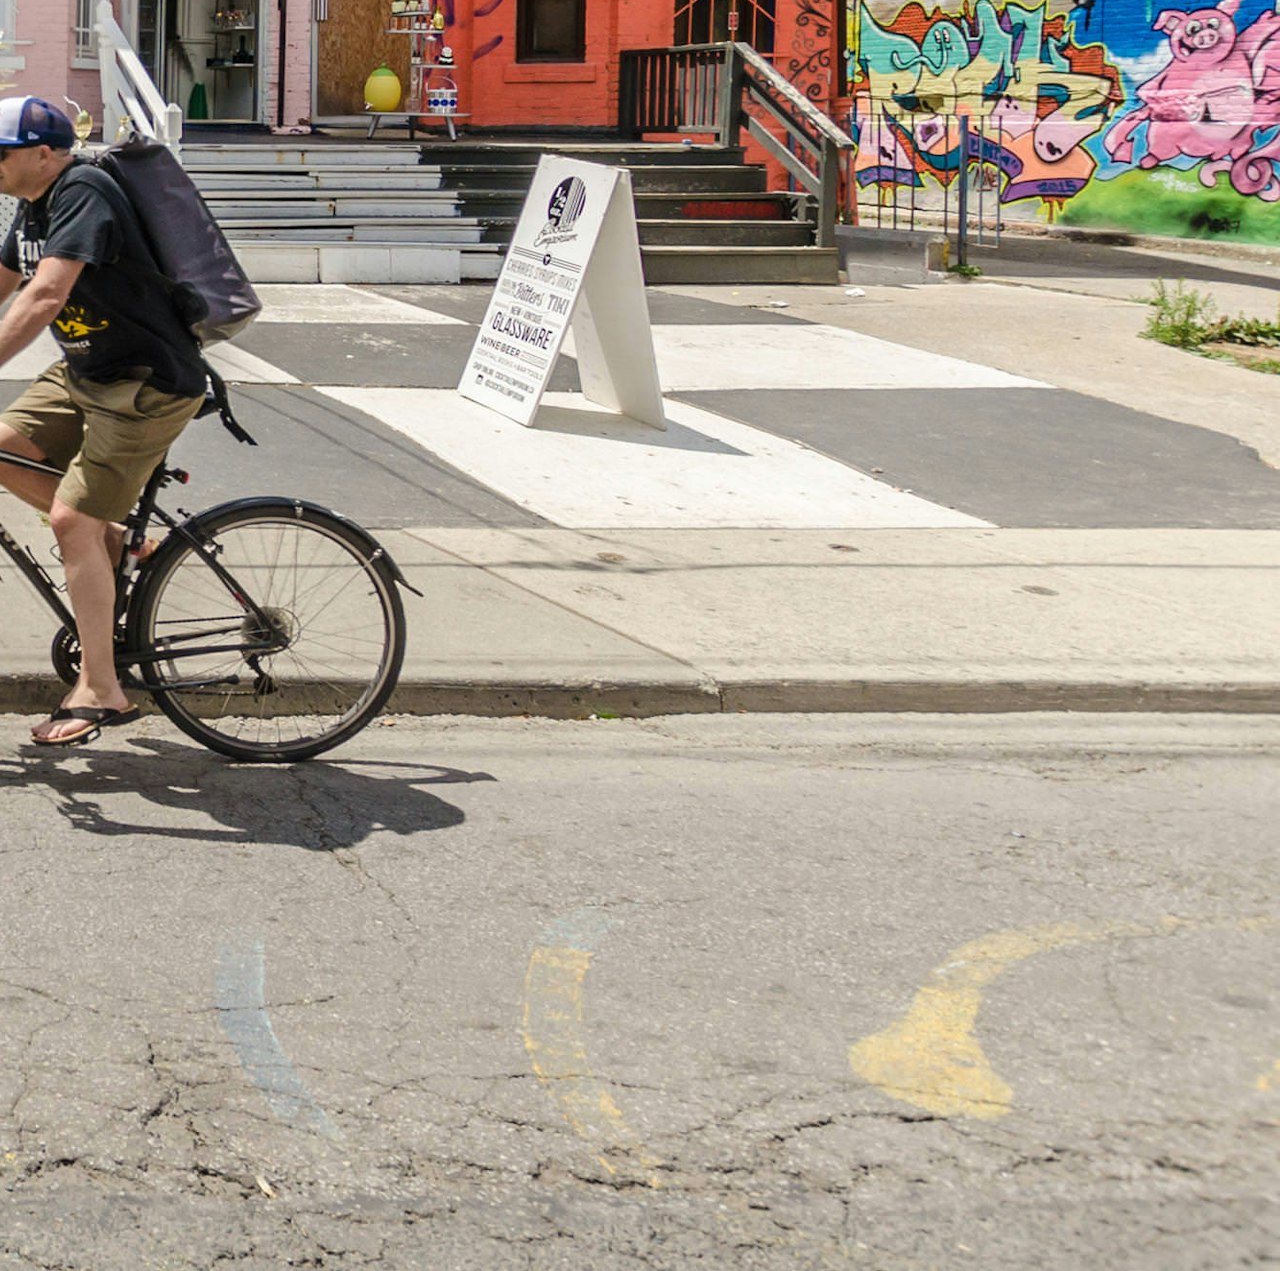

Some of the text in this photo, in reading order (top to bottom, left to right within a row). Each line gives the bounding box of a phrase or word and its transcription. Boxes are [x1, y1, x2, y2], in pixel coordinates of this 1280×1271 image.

[547, 294, 570, 316] TIKI
[492, 311, 553, 350] GLASSWARE
[480, 335, 521, 357] WINE BEER
